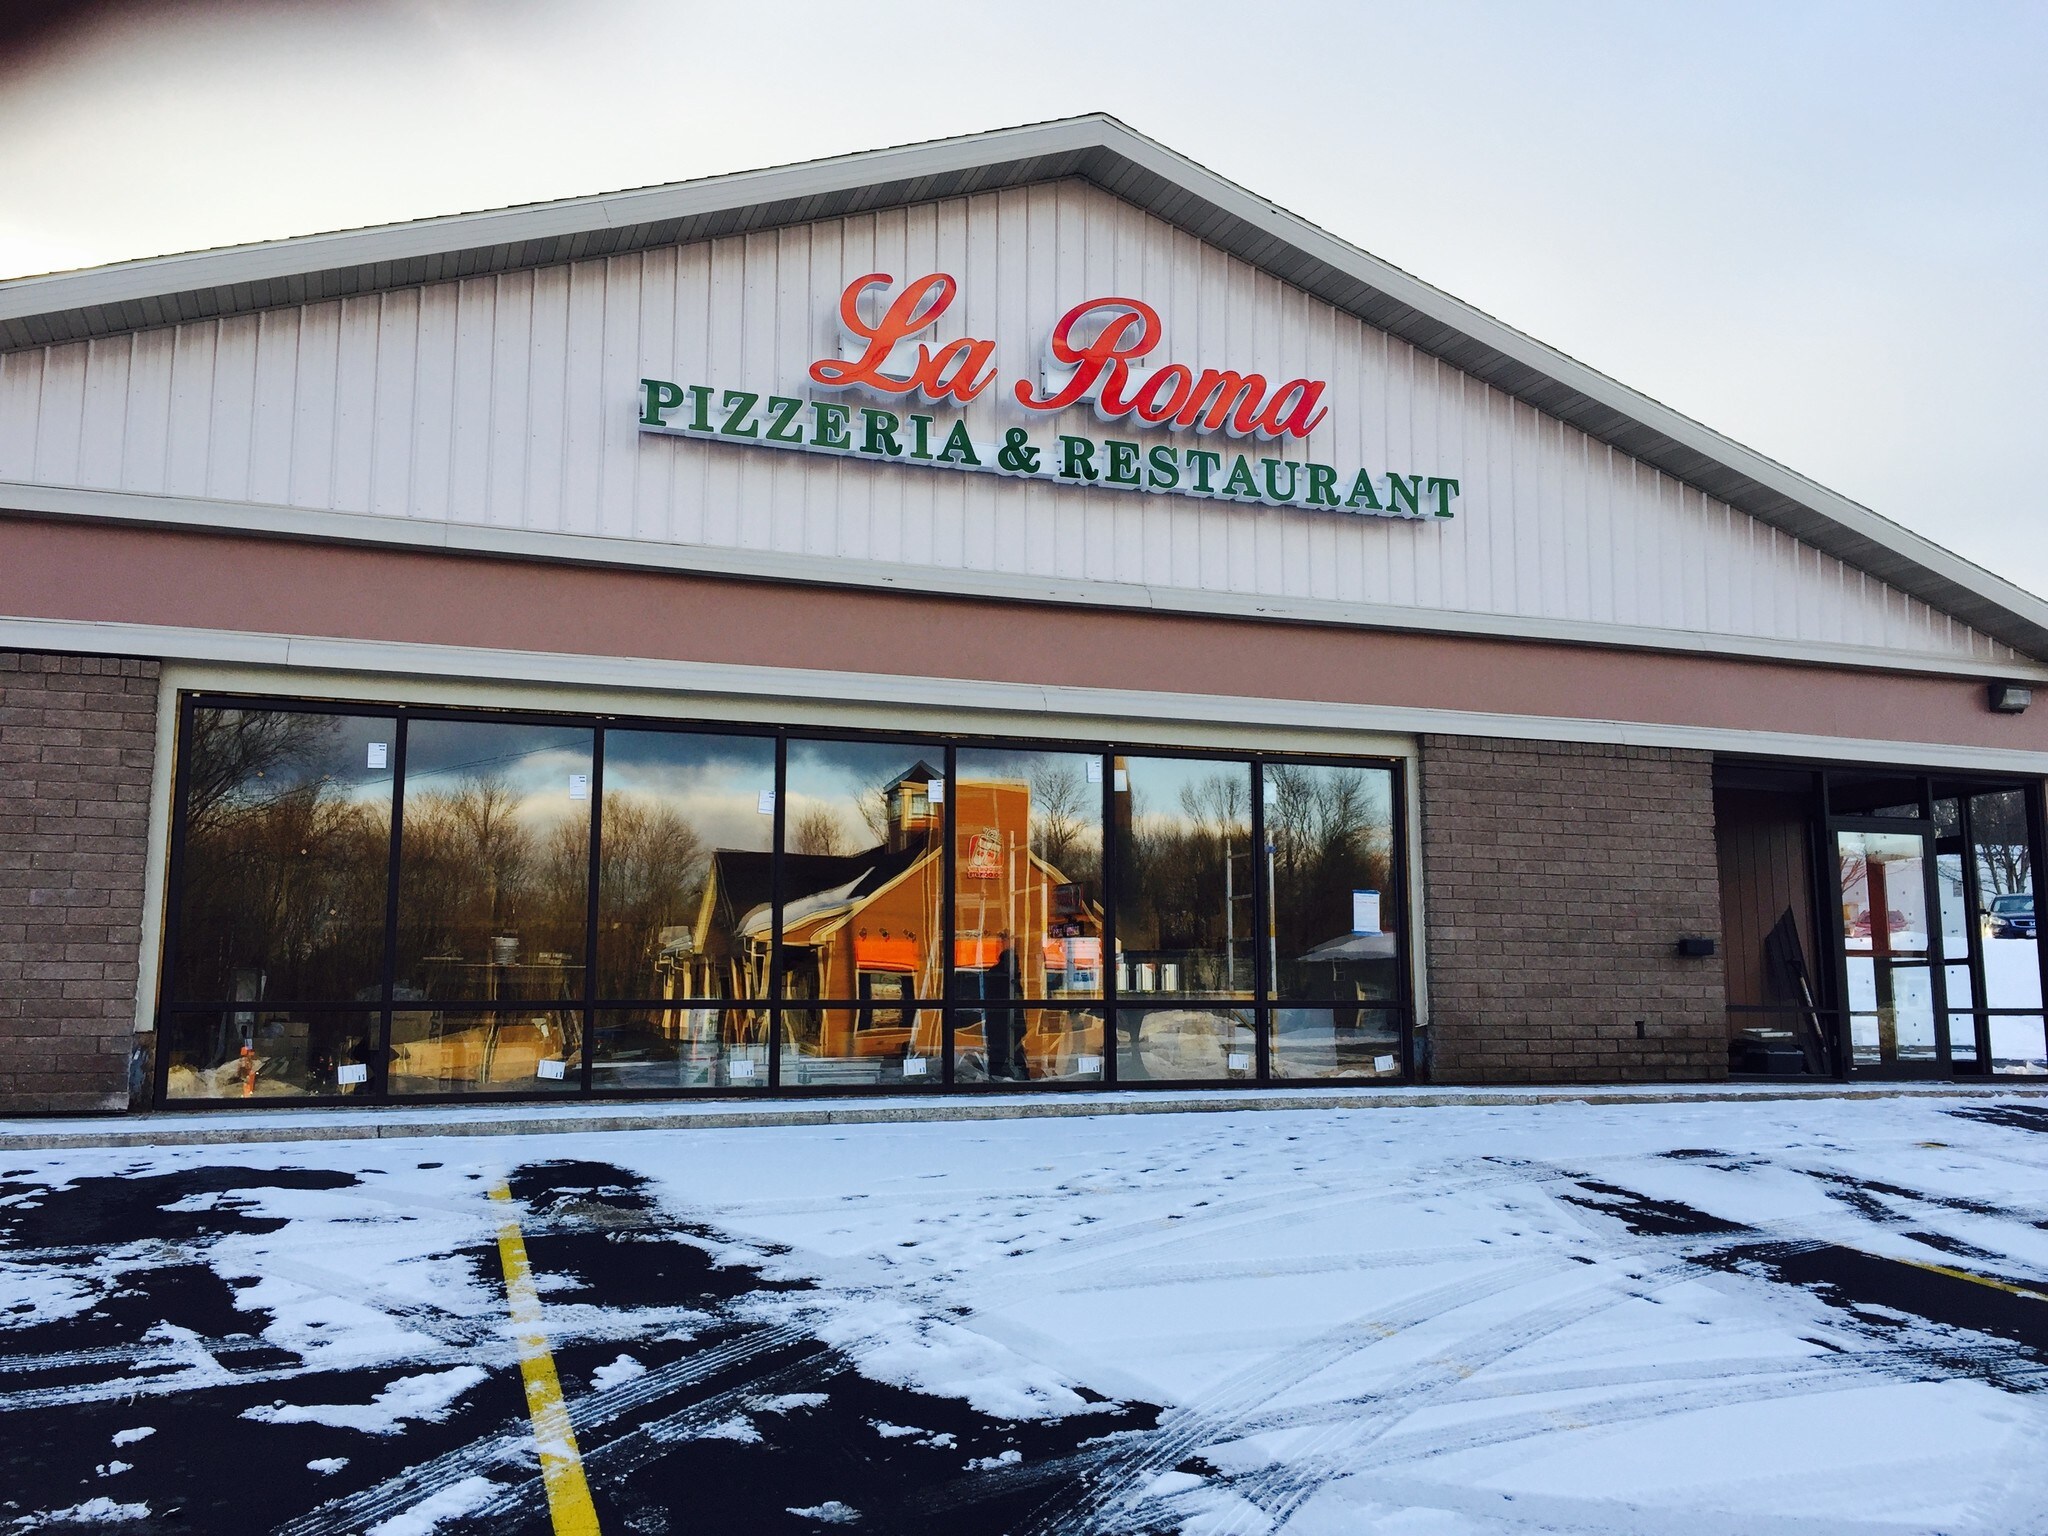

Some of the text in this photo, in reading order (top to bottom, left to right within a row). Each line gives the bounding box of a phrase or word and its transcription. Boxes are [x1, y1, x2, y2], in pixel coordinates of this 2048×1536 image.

[809, 273, 1329, 439] La Roma
[639, 378, 1460, 519] PIZZERIA & RESTAURANT
